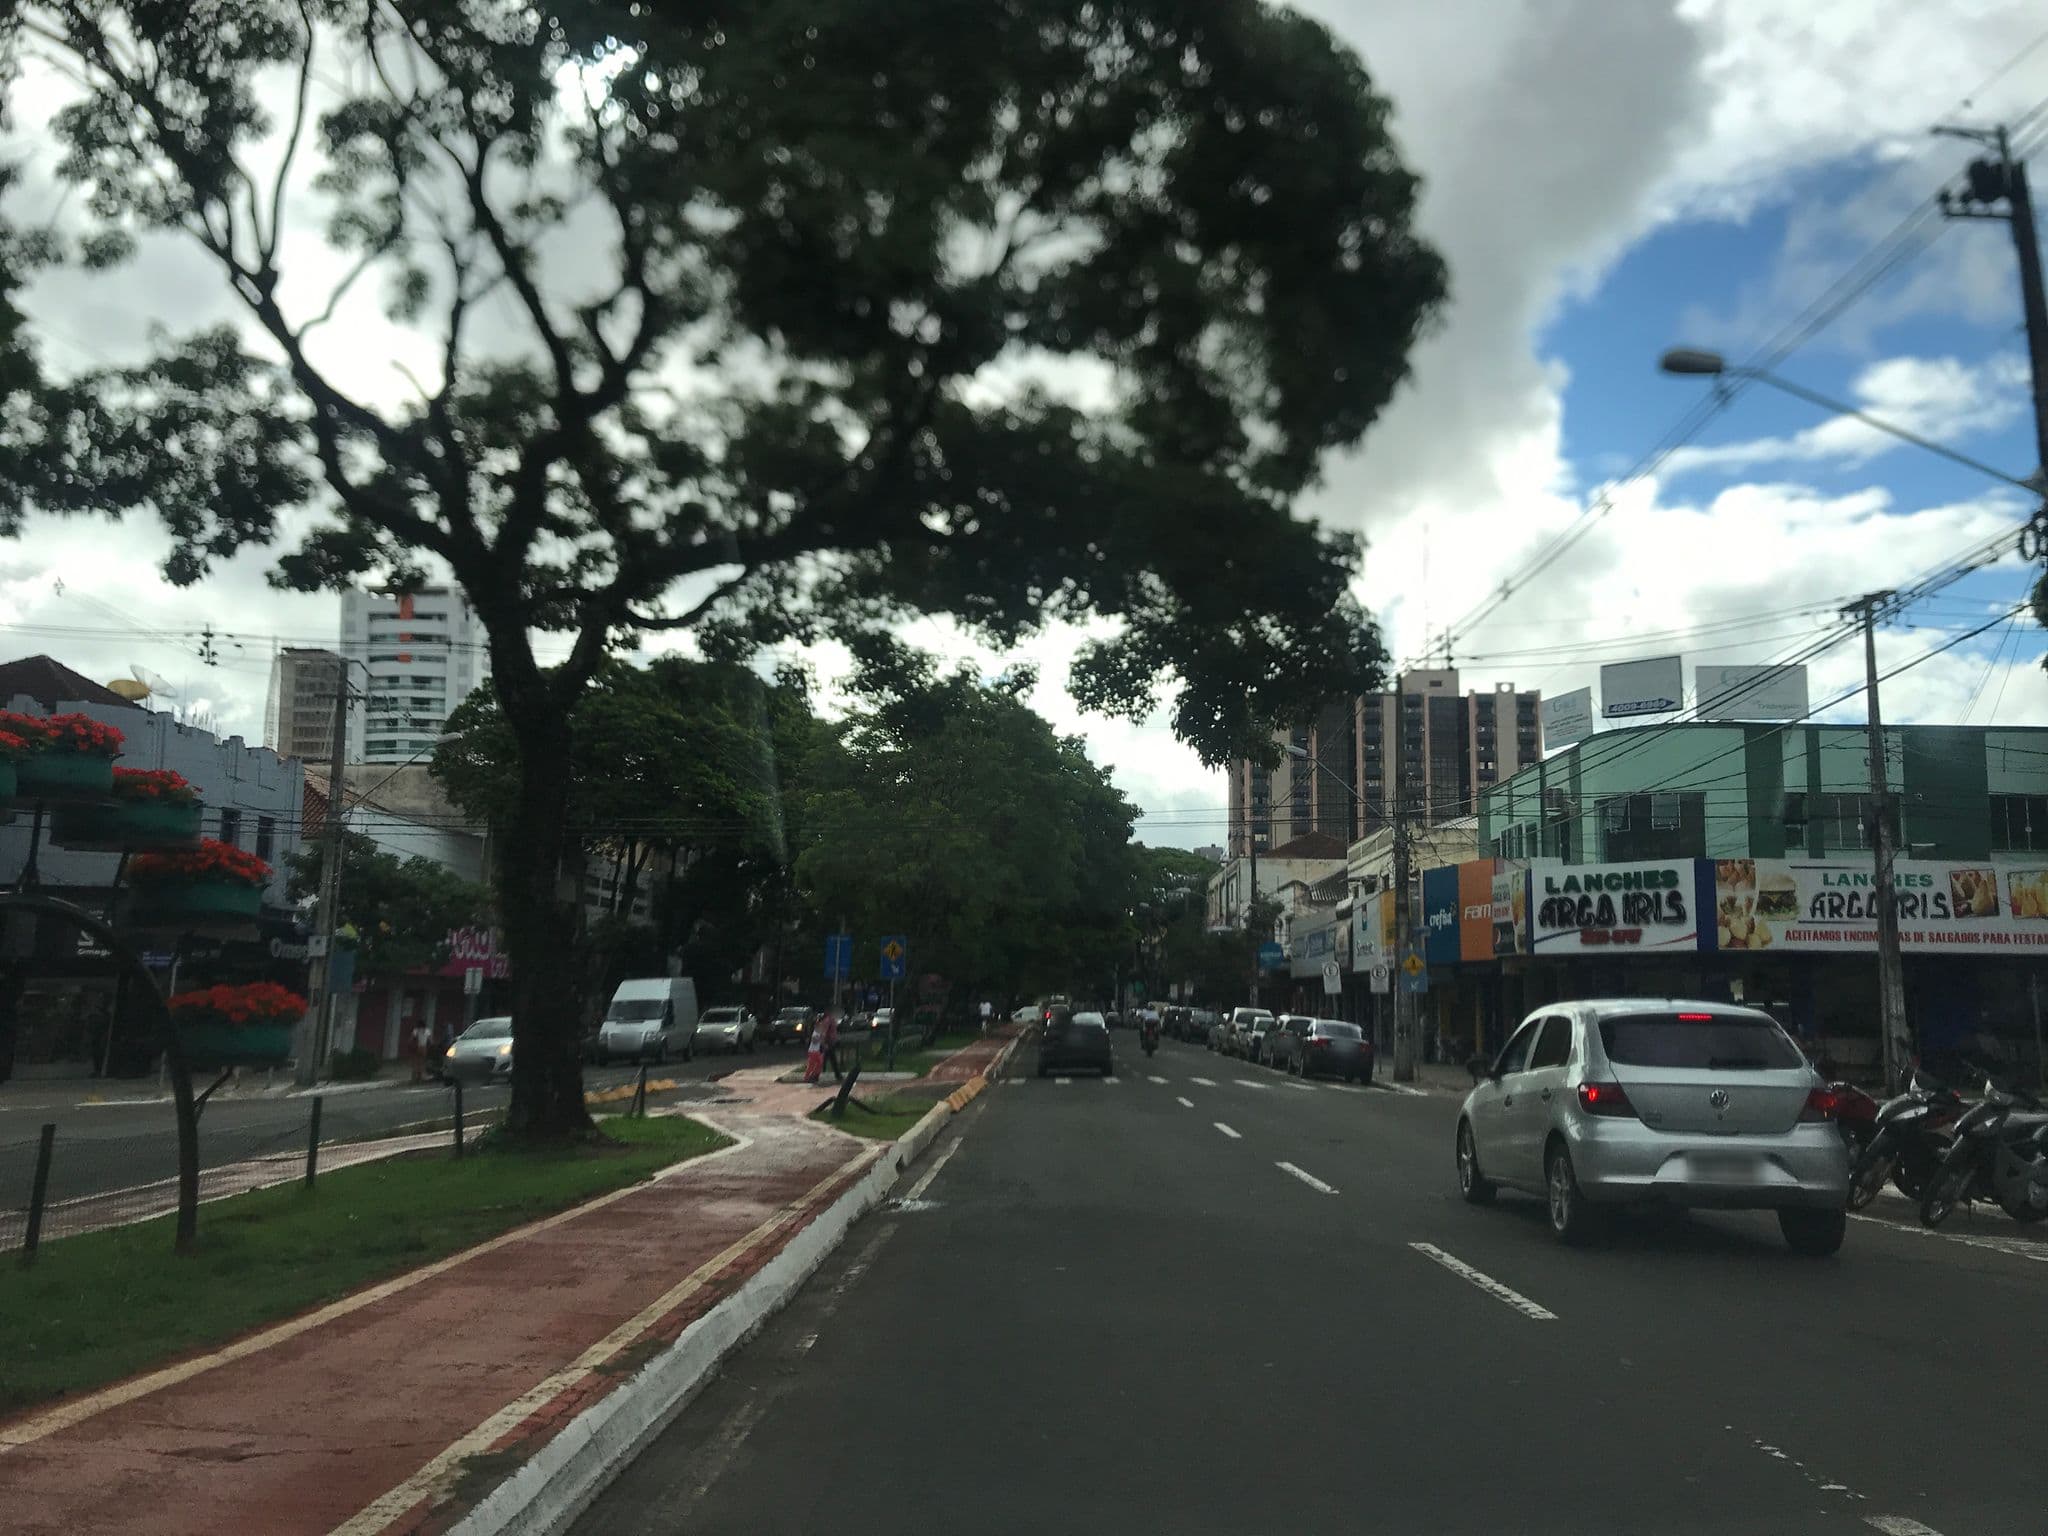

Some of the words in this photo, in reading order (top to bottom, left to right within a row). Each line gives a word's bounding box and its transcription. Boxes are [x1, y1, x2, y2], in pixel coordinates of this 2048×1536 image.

[1544, 870, 1680, 893] LANCHES
[1896, 891, 1950, 919] RIS
[1843, 930, 1911, 943] ENCOMAS
[1983, 932, 2010, 944] PARA
